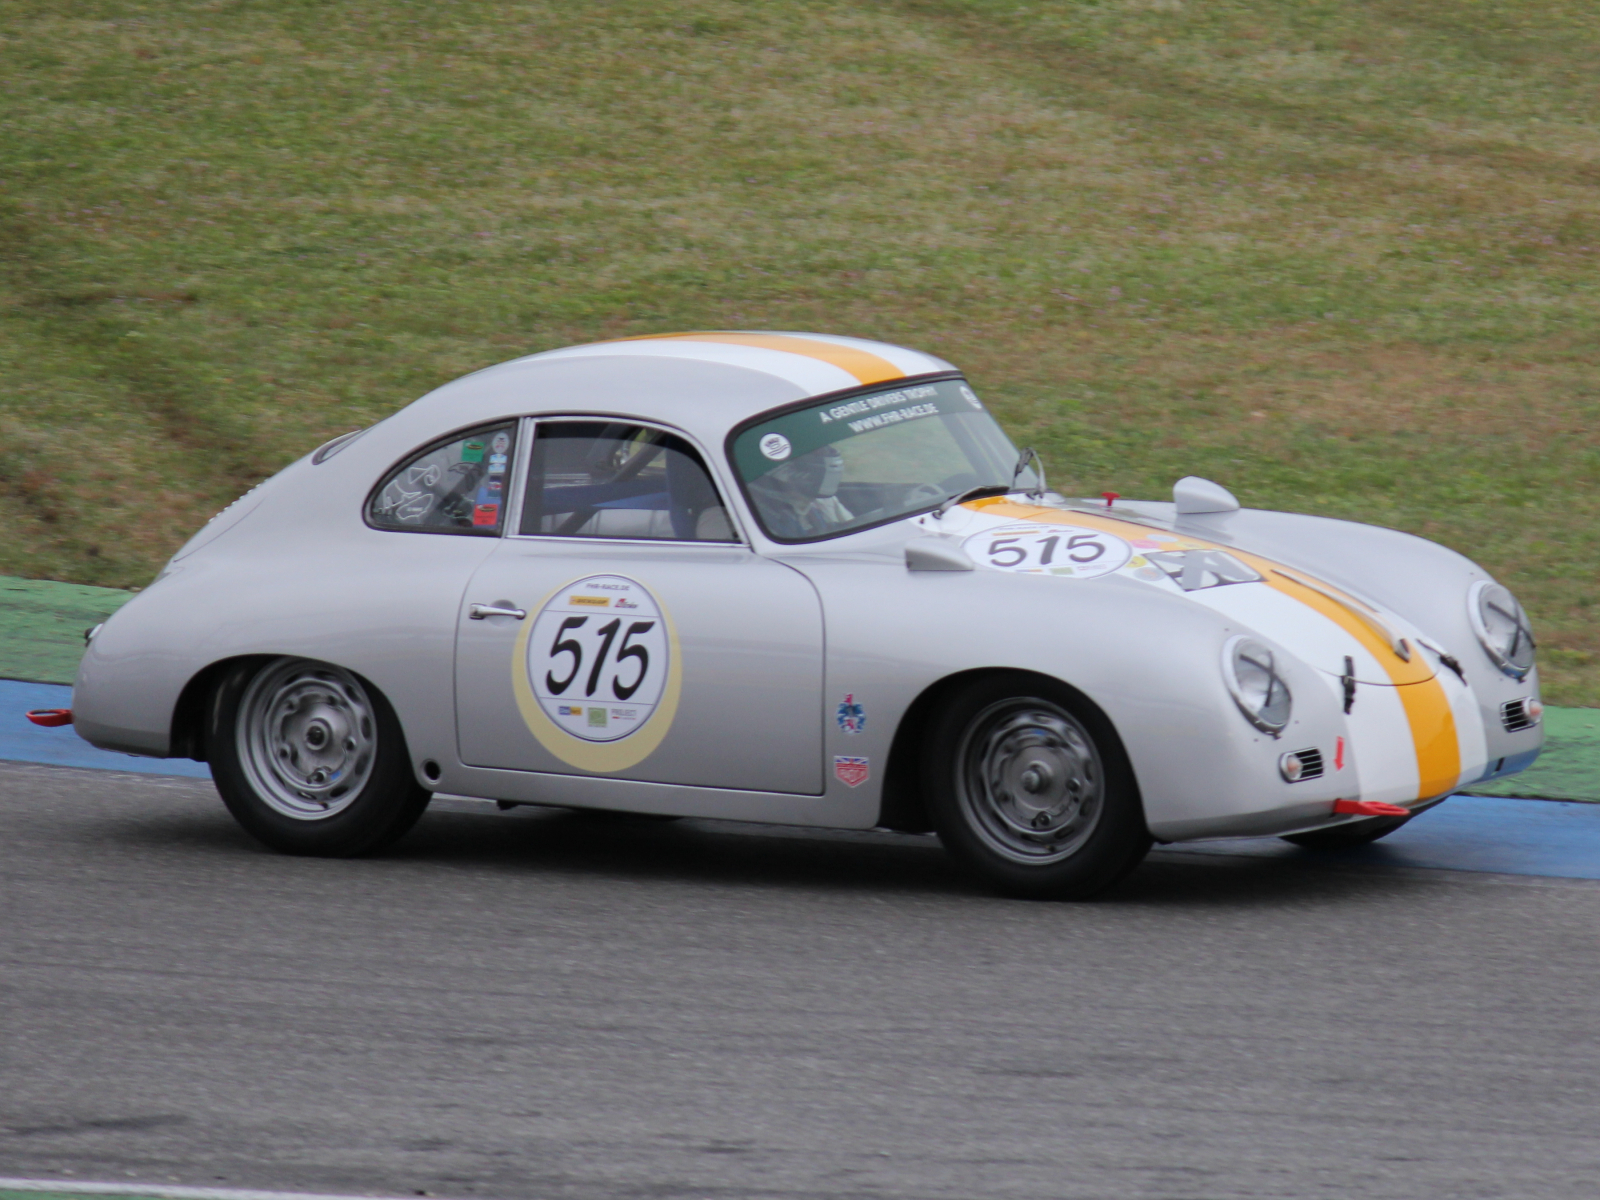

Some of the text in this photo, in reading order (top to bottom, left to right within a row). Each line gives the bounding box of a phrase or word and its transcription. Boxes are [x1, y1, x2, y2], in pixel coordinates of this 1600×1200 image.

[820, 412, 831, 423] A
[831, 401, 870, 419] GENTLE
[988, 534, 1106, 567] 515
[546, 616, 655, 701] 515
